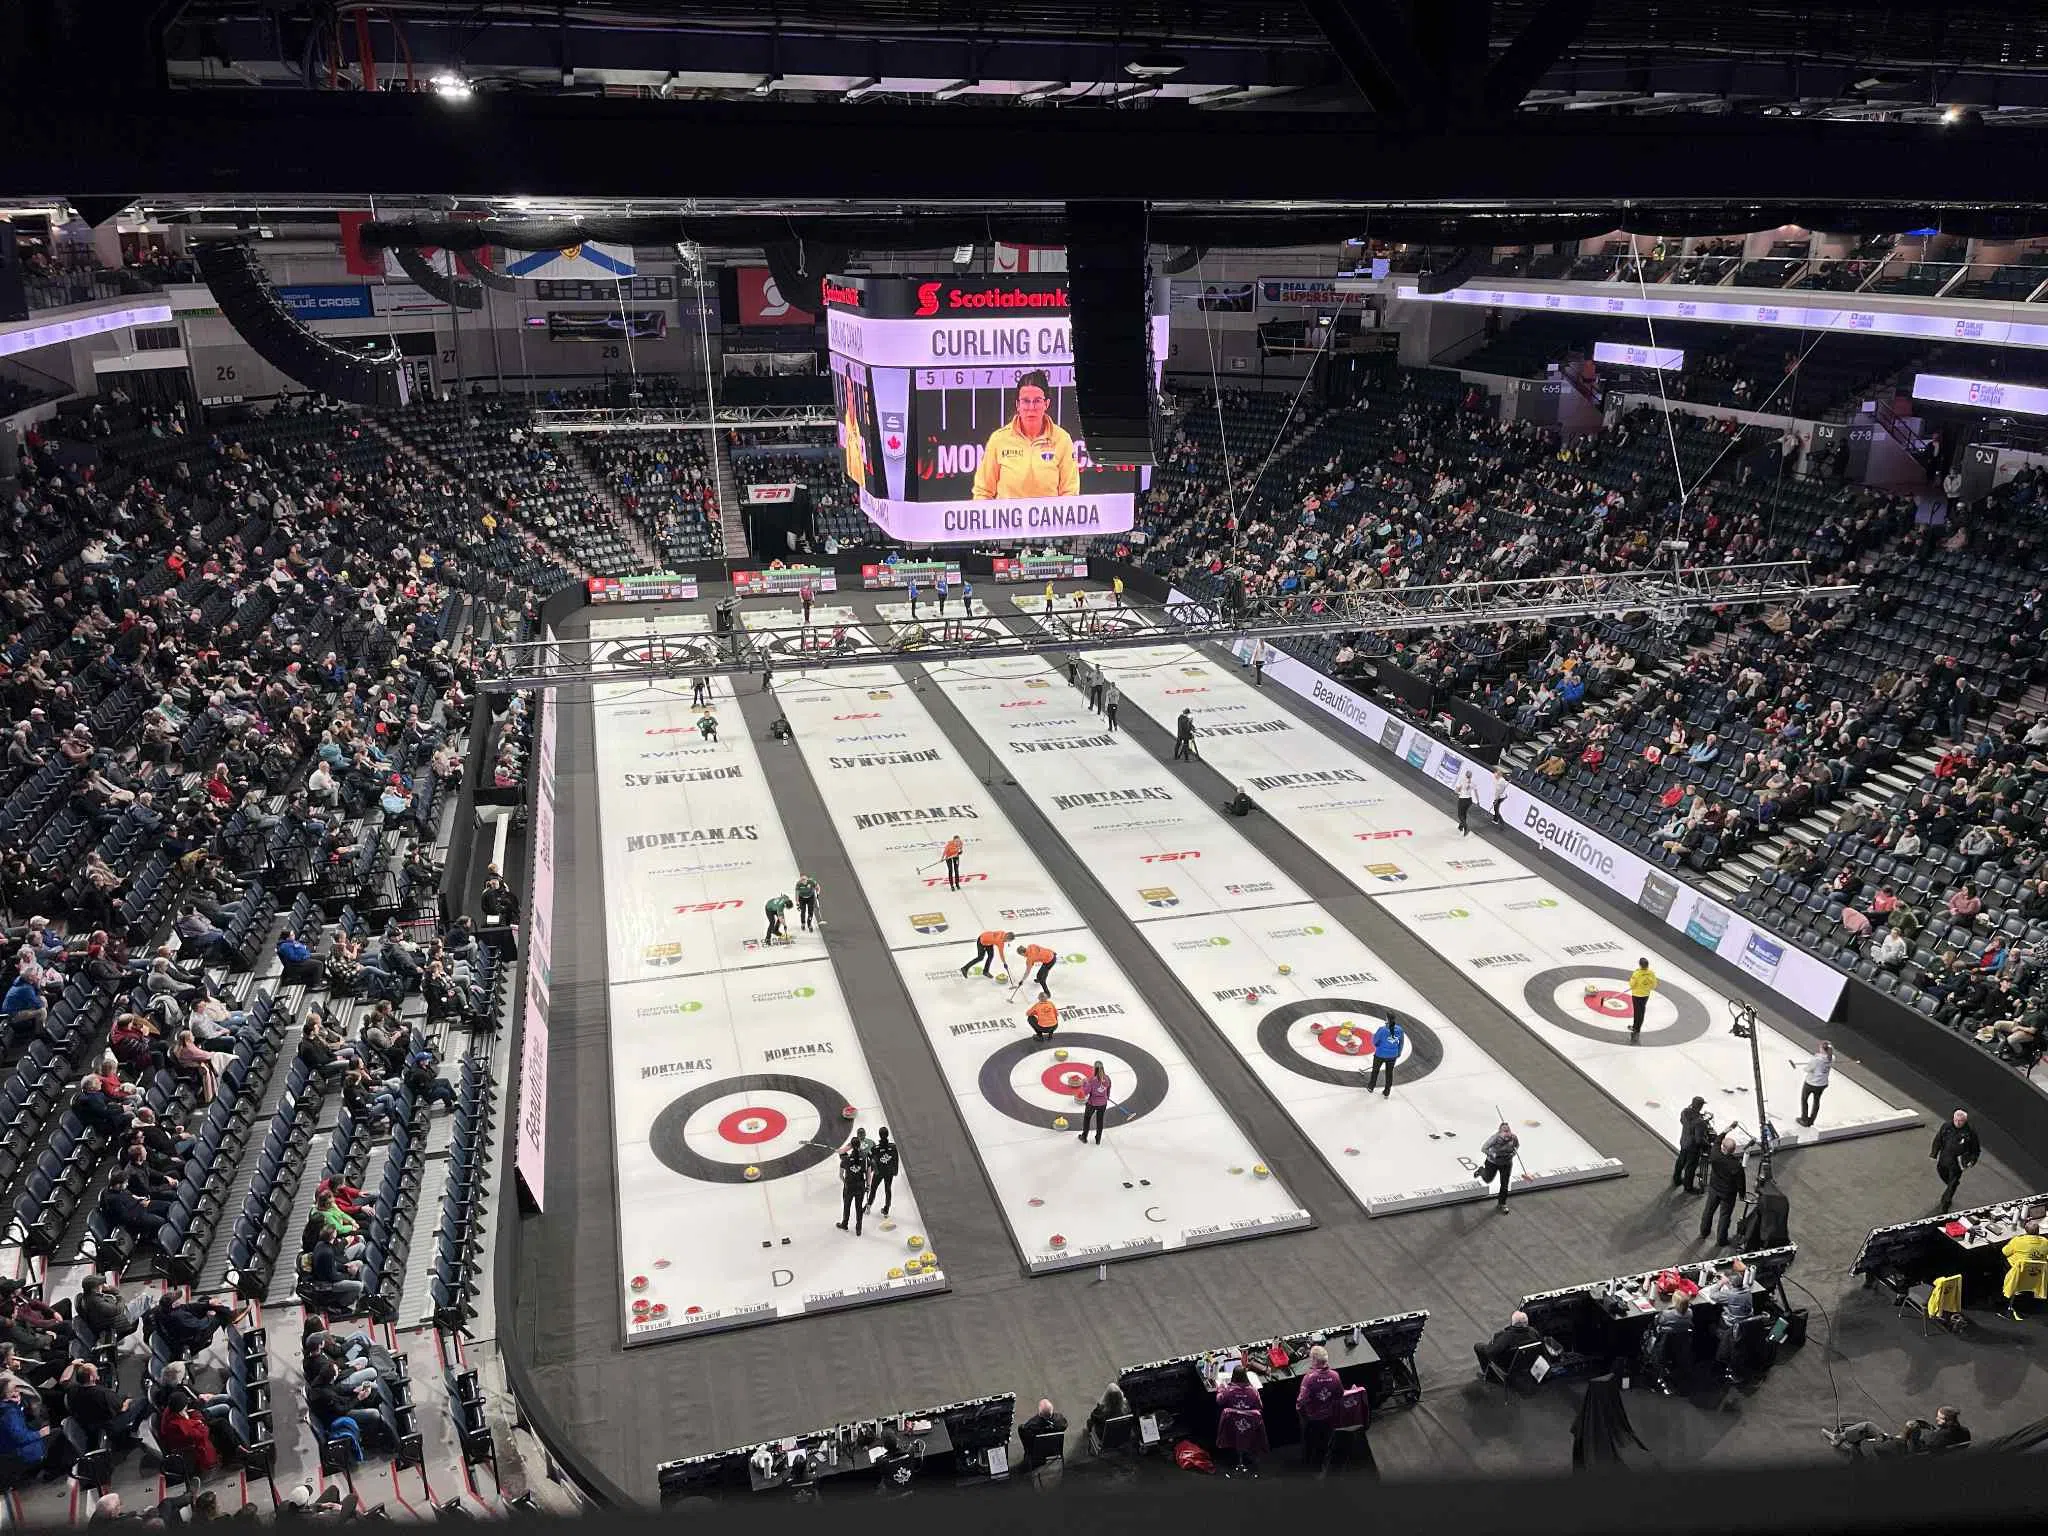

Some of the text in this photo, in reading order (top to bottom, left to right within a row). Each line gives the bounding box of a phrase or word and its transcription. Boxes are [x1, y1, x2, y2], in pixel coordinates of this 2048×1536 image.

[318, 299, 360, 307] CROSS
[949, 288, 1068, 308] Scotiabank
[932, 329, 1030, 357] CURLING
[442, 350, 456, 363] 27
[602, 346, 620, 358] 28
[216, 366, 236, 381] 26
[926, 371, 935, 385] 5
[955, 371, 964, 384] 6
[985, 370, 993, 384] 7
[754, 487, 792, 499] TSN
[944, 504, 1100, 531] CURLING CANADA
[1313, 679, 1367, 726] BeautiTone
[853, 804, 980, 831] MONTANA'S
[627, 824, 759, 852] MONTANA'S
[1524, 804, 1615, 876] BeautiTone
[1140, 851, 1201, 863] TSN
[673, 899, 745, 914] TSN
[1456, 1156, 1478, 1171] B
[1145, 1206, 1167, 1222] C
[771, 1269, 793, 1287] D
